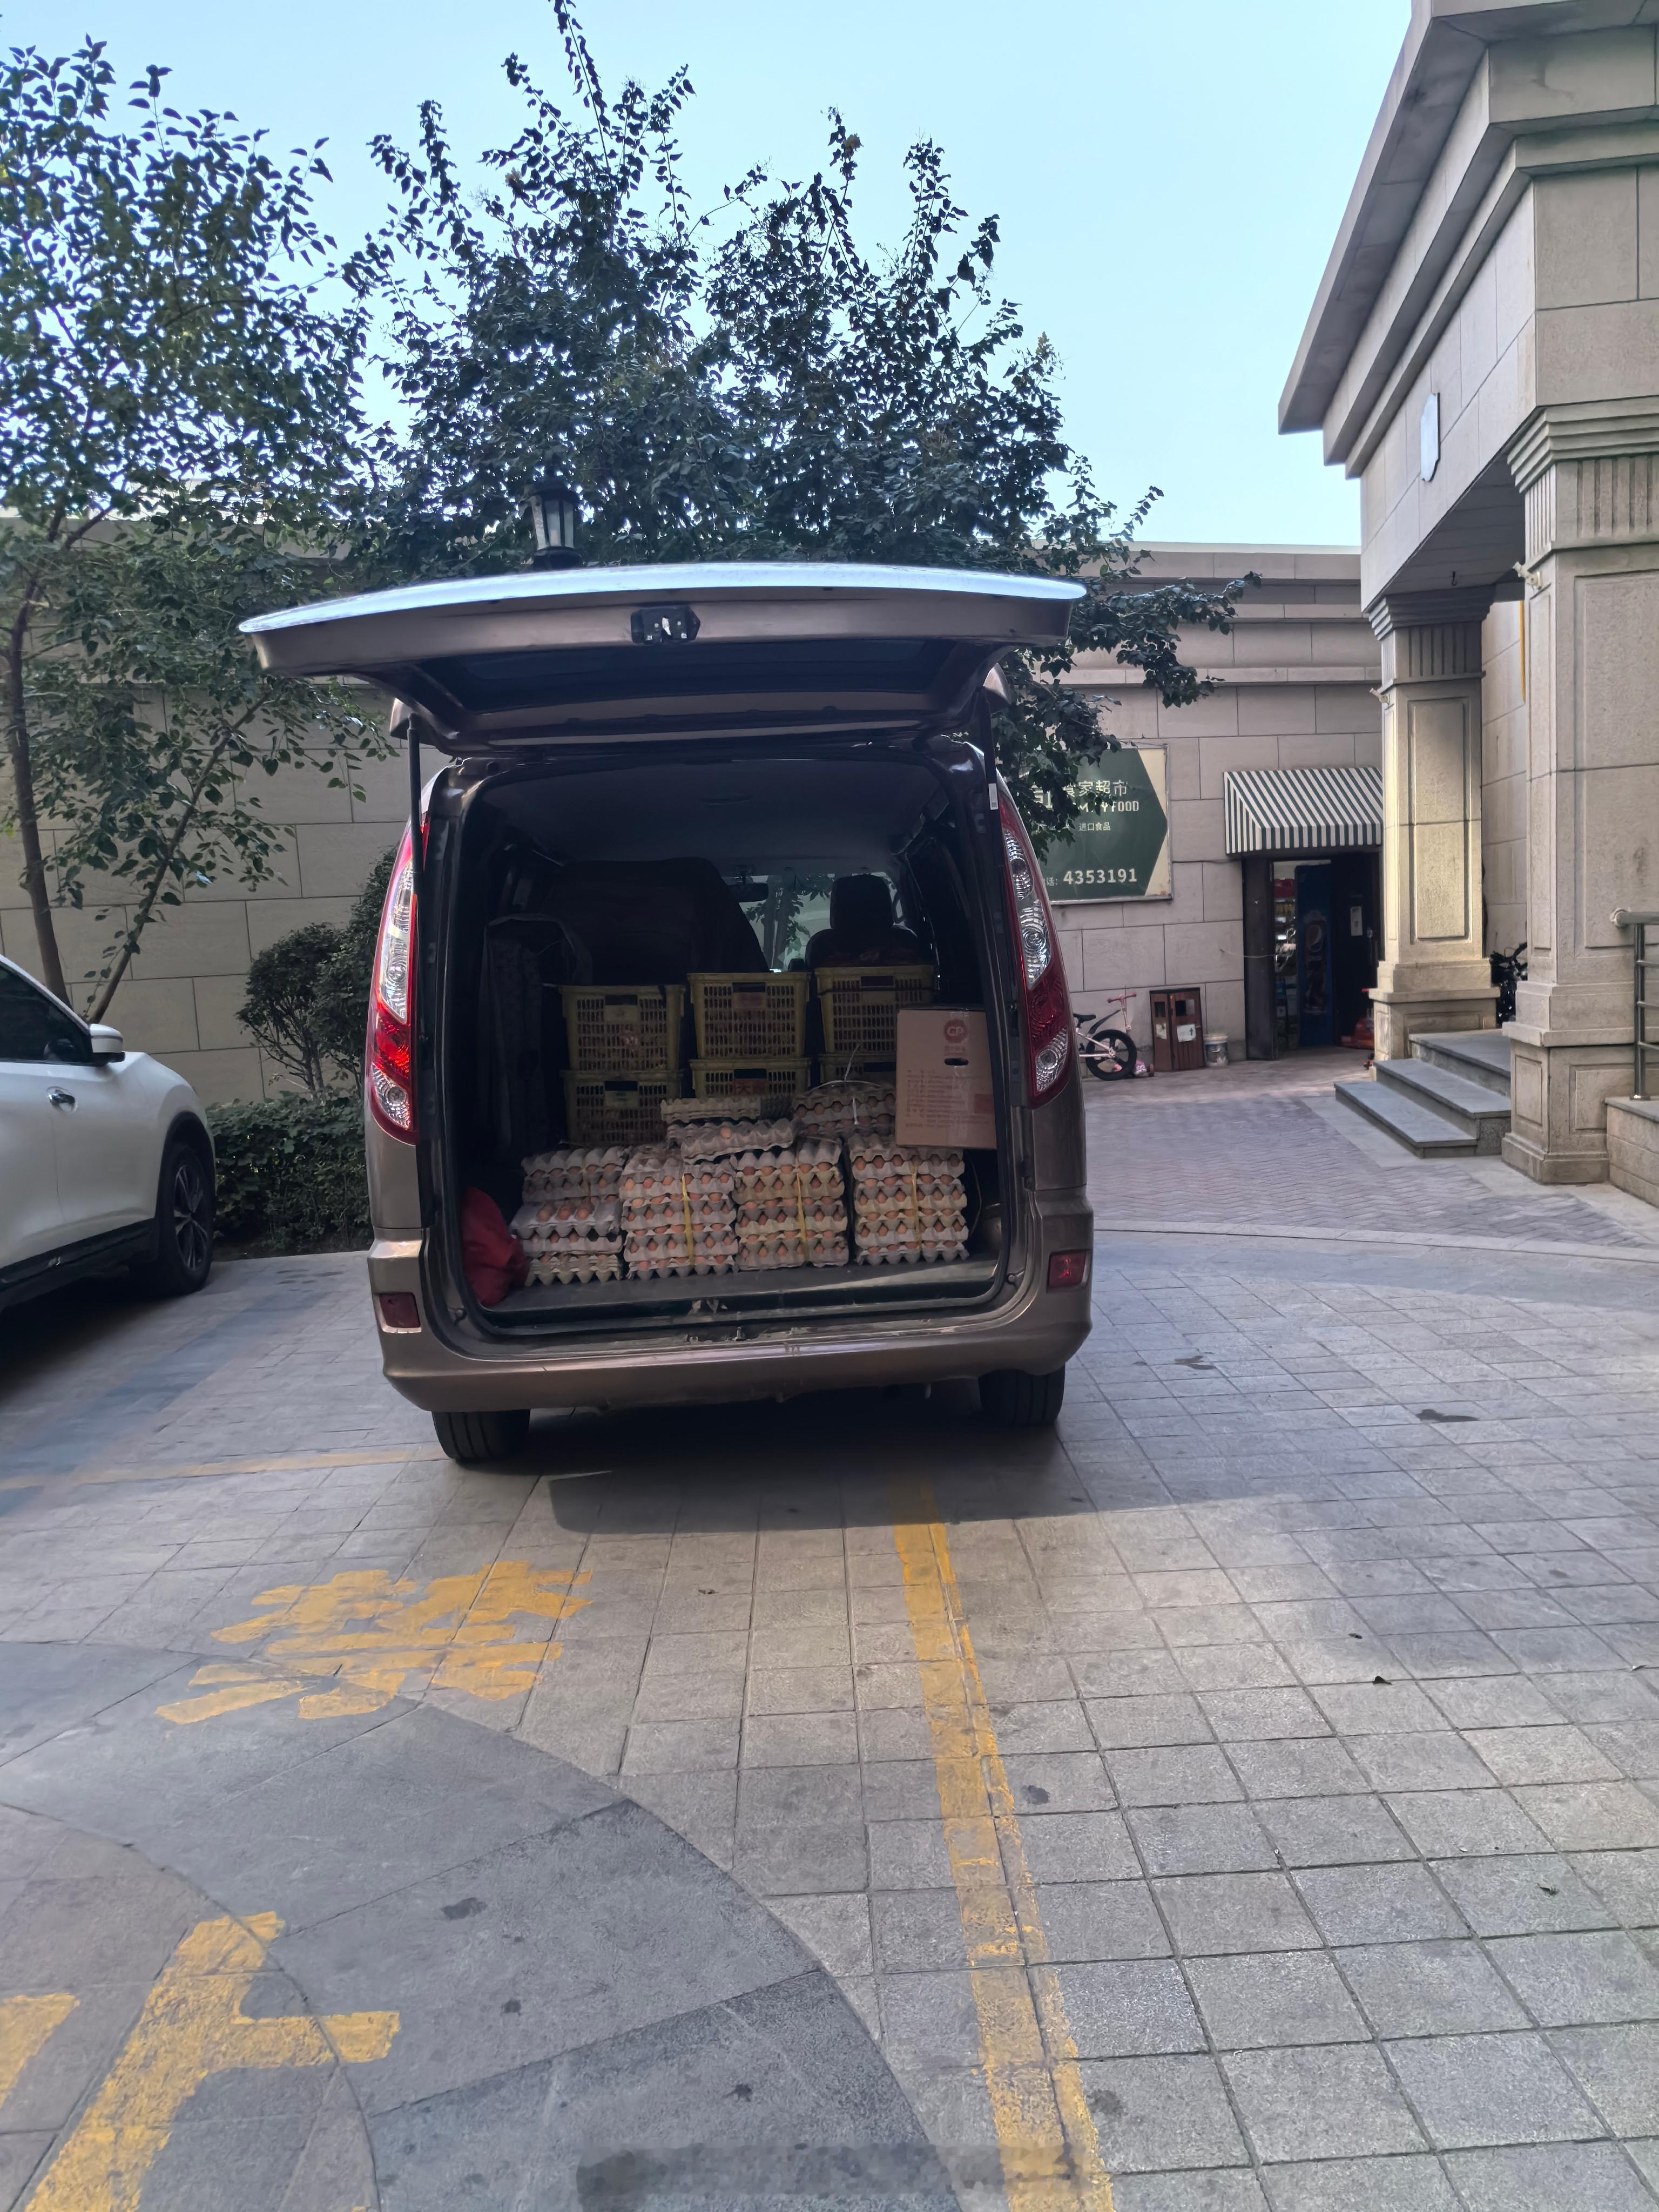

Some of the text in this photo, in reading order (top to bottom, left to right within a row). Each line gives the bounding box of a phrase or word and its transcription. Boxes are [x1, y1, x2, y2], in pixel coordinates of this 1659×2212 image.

[1111, 800, 1139, 812] FOOD
[1079, 822, 1111, 831] 进口食品
[1063, 868, 1137, 885] 4353191
